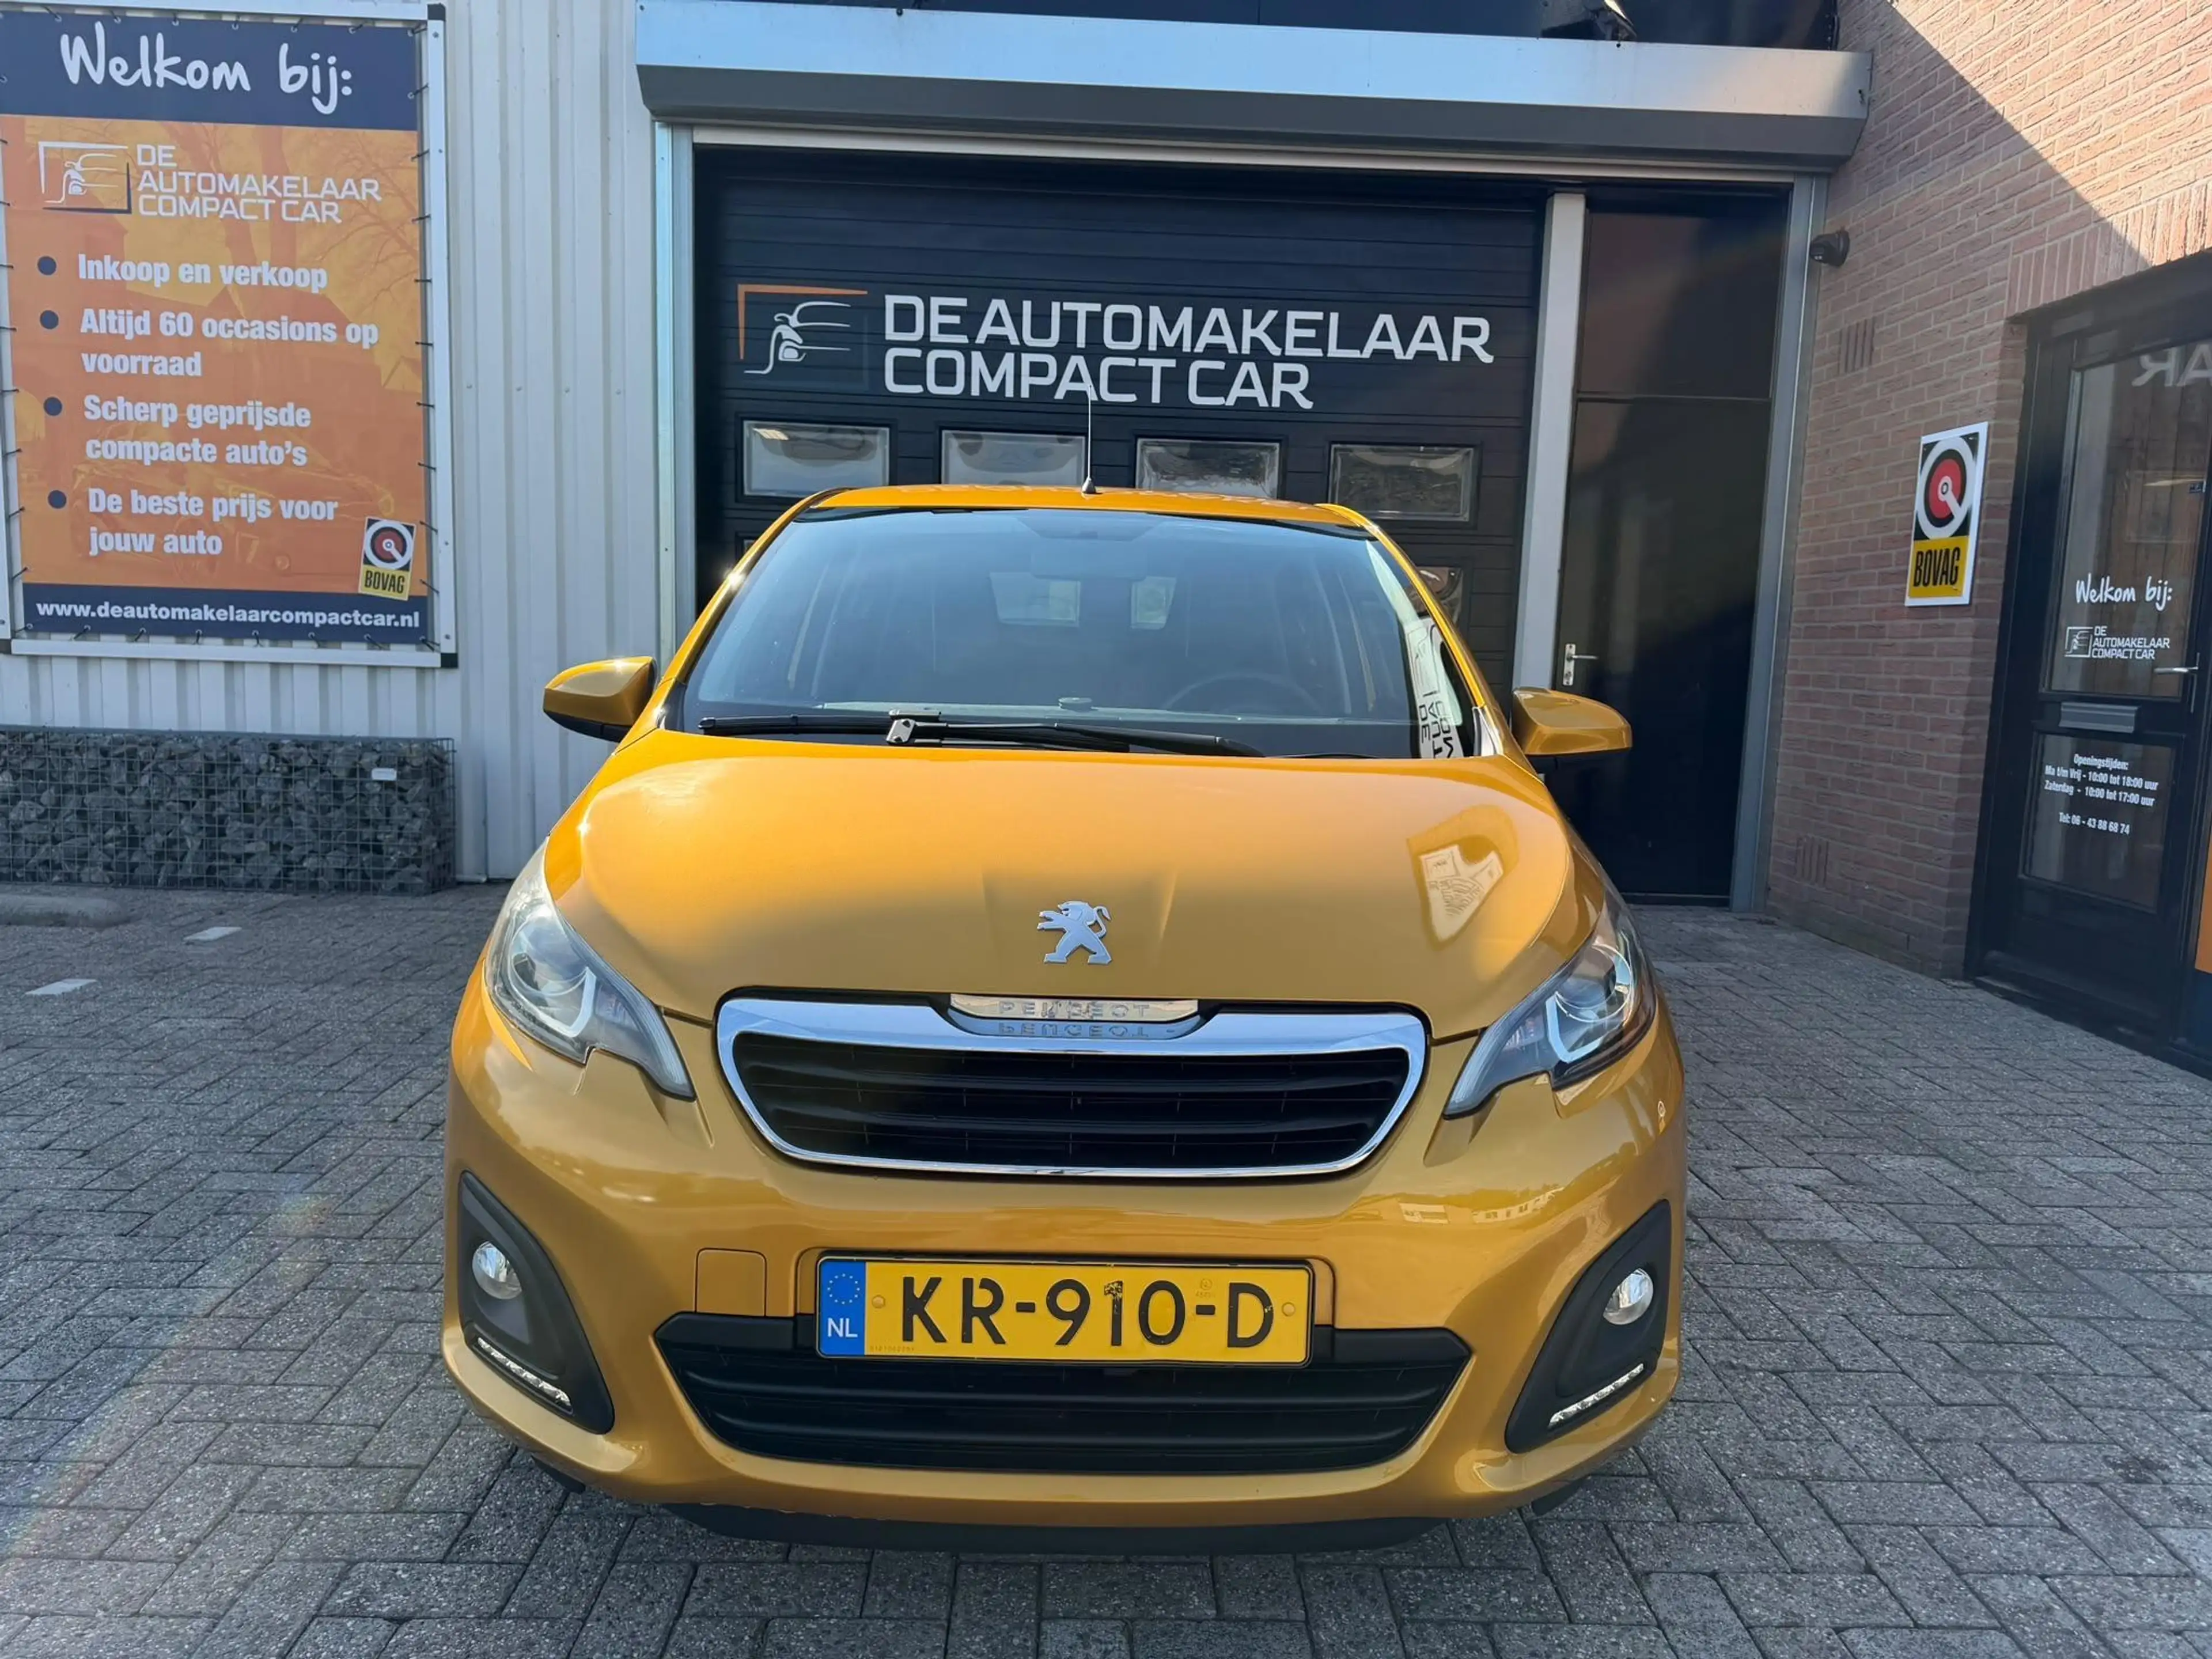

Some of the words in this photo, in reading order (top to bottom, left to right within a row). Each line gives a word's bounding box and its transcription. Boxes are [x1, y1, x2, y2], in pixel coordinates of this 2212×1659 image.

[60, 21, 251, 91] Welkom
[278, 43, 352, 114] bij:
[137, 145, 177, 167] DE
[137, 171, 382, 202] AUTOMAKELAAR
[138, 195, 275, 220] COMPACT
[282, 200, 342, 224] CAR
[78, 254, 170, 285] Inkoop
[179, 263, 210, 284] en
[219, 262, 327, 293] verkoop
[81, 308, 150, 340] Altijd
[159, 312, 194, 337] 60
[202, 315, 337, 343] occasions
[346, 323, 378, 349] op
[885, 294, 969, 343] DE
[975, 299, 1494, 363] AUTOMAKELAAR
[81, 352, 202, 376] voorraad
[885, 348, 1176, 403] COMPACT
[1188, 359, 1314, 410] CAR
[84, 395, 179, 428] Scherp
[187, 400, 311, 431] geprijsde
[85, 438, 217, 465] compacte
[226, 440, 308, 466] auto's
[88, 488, 122, 513] De
[131, 490, 204, 516] beste
[212, 493, 272, 523] prijs
[279, 498, 338, 521] voor
[89, 527, 155, 556] jouw
[164, 530, 222, 555] auto
[1914, 547, 1960, 587] BOVAG
[365, 570, 405, 593] BOVAG
[2076, 573, 2136, 603] Welkom
[2145, 576, 2172, 611] bij:
[36, 601, 420, 629] www.deautomakelaarcompactcar.nl
[2092, 638, 2170, 649] AUTOMAKELAAR
[2094, 626, 2108, 636] DE
[2092, 649, 2133, 659] COMPACT
[2135, 649, 2155, 660] CAR
[2074, 753, 2129, 770] Openingstijden:
[2045, 765, 2055, 775] Ma
[2088, 771, 2108, 783] 10:00
[2109, 774, 2120, 786] tot
[2122, 777, 2143, 789] 18:00
[2144, 781, 2159, 790] uur
[2044, 780, 2074, 796] Zaterdag
[2085, 786, 2105, 798] 10:00
[2106, 789, 2116, 801] tot
[2119, 791, 2139, 804] 17:00
[2141, 796, 2155, 806] uur
[2071, 815, 2081, 825] 06
[2087, 818, 2097, 828] 43
[2097, 820, 2107, 831] 88
[2108, 822, 2119, 833] 68
[2120, 823, 2130, 835] 74
[902, 1276, 1274, 1348] KR-910-D
[827, 1317, 858, 1338] NL
